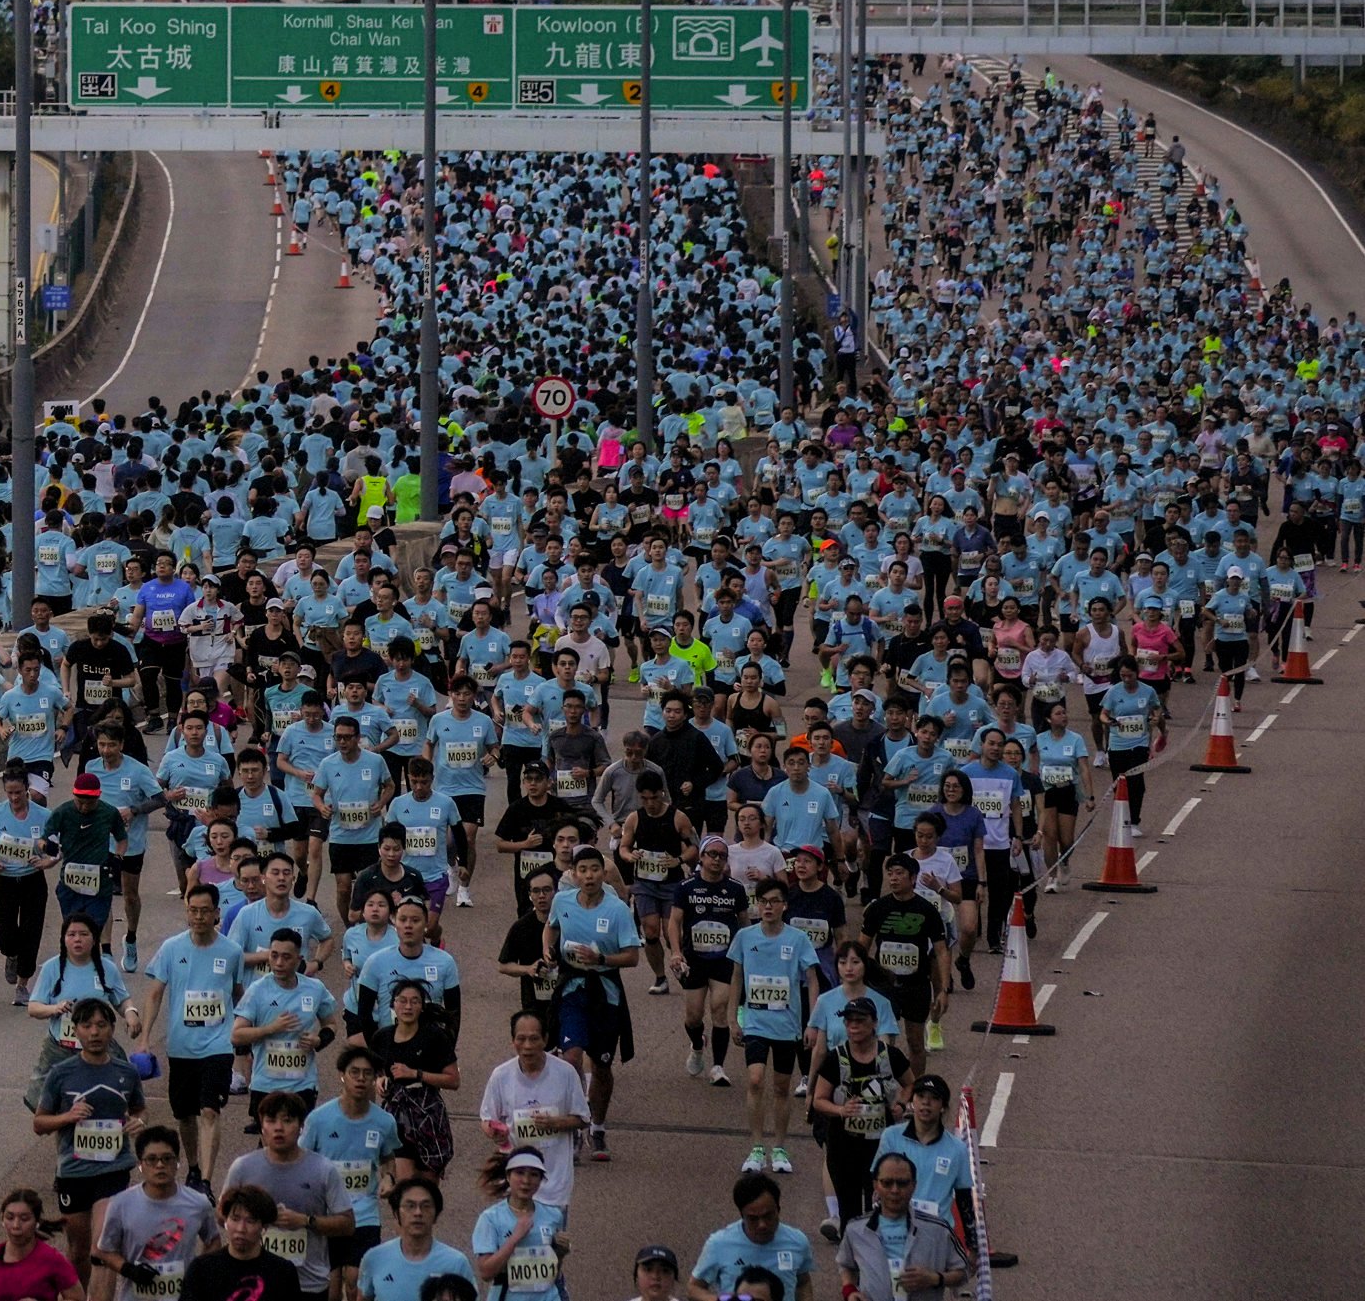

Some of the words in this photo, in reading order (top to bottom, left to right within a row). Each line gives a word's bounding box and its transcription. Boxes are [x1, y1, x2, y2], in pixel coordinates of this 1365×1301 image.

[81, 17, 109, 36] Tai
[120, 18, 156, 36] Koo
[167, 17, 217, 39] Shing
[346, 14, 382, 30] Shau
[391, 15, 414, 29] Kei
[537, 16, 617, 33] Kowloon
[329, 32, 361, 46] Chai
[368, 32, 401, 46] Wan
[720, 43, 729, 55] E
[106, 44, 192, 70] 太古城
[544, 41, 656, 70] 九龍(東)
[81, 75, 99, 84] EXIT
[100, 76, 114, 96] 4
[325, 84, 336, 97] 4
[472, 85, 484, 98] 4
[521, 81, 539, 91] EXIT
[539, 82, 553, 101] 5
[630, 84, 642, 99] 2
[17, 329, 23, 339] A
[539, 389, 566, 406] 70
[39, 553, 58, 561] P3208
[97, 560, 116, 568] P3209
[647, 601, 668, 611] M1838
[153, 617, 175, 626] K3115
[85, 689, 112, 698] M3028
[18, 721, 45, 731] M2339
[1118, 723, 1144, 732] M1584
[399, 728, 417, 737] 1480
[448, 751, 477, 761] M0931
[558, 779, 585, 790] M2509
[908, 792, 938, 802] M0022
[974, 801, 1001, 811] K0590
[340, 811, 368, 822] M1961
[406, 837, 436, 847] M2059
[66, 874, 97, 887] M2471
[688, 895, 735, 906] MoveSport
[694, 933, 728, 944] M0551
[881, 953, 917, 966] M3485
[751, 989, 787, 1001] K1732
[186, 1004, 222, 1017] K1391
[268, 1054, 307, 1067] M0309
[77, 1134, 120, 1150] M0981
[345, 1175, 369, 1189] 929
[263, 1237, 305, 1253] M4180
[511, 1263, 556, 1280] M0101
